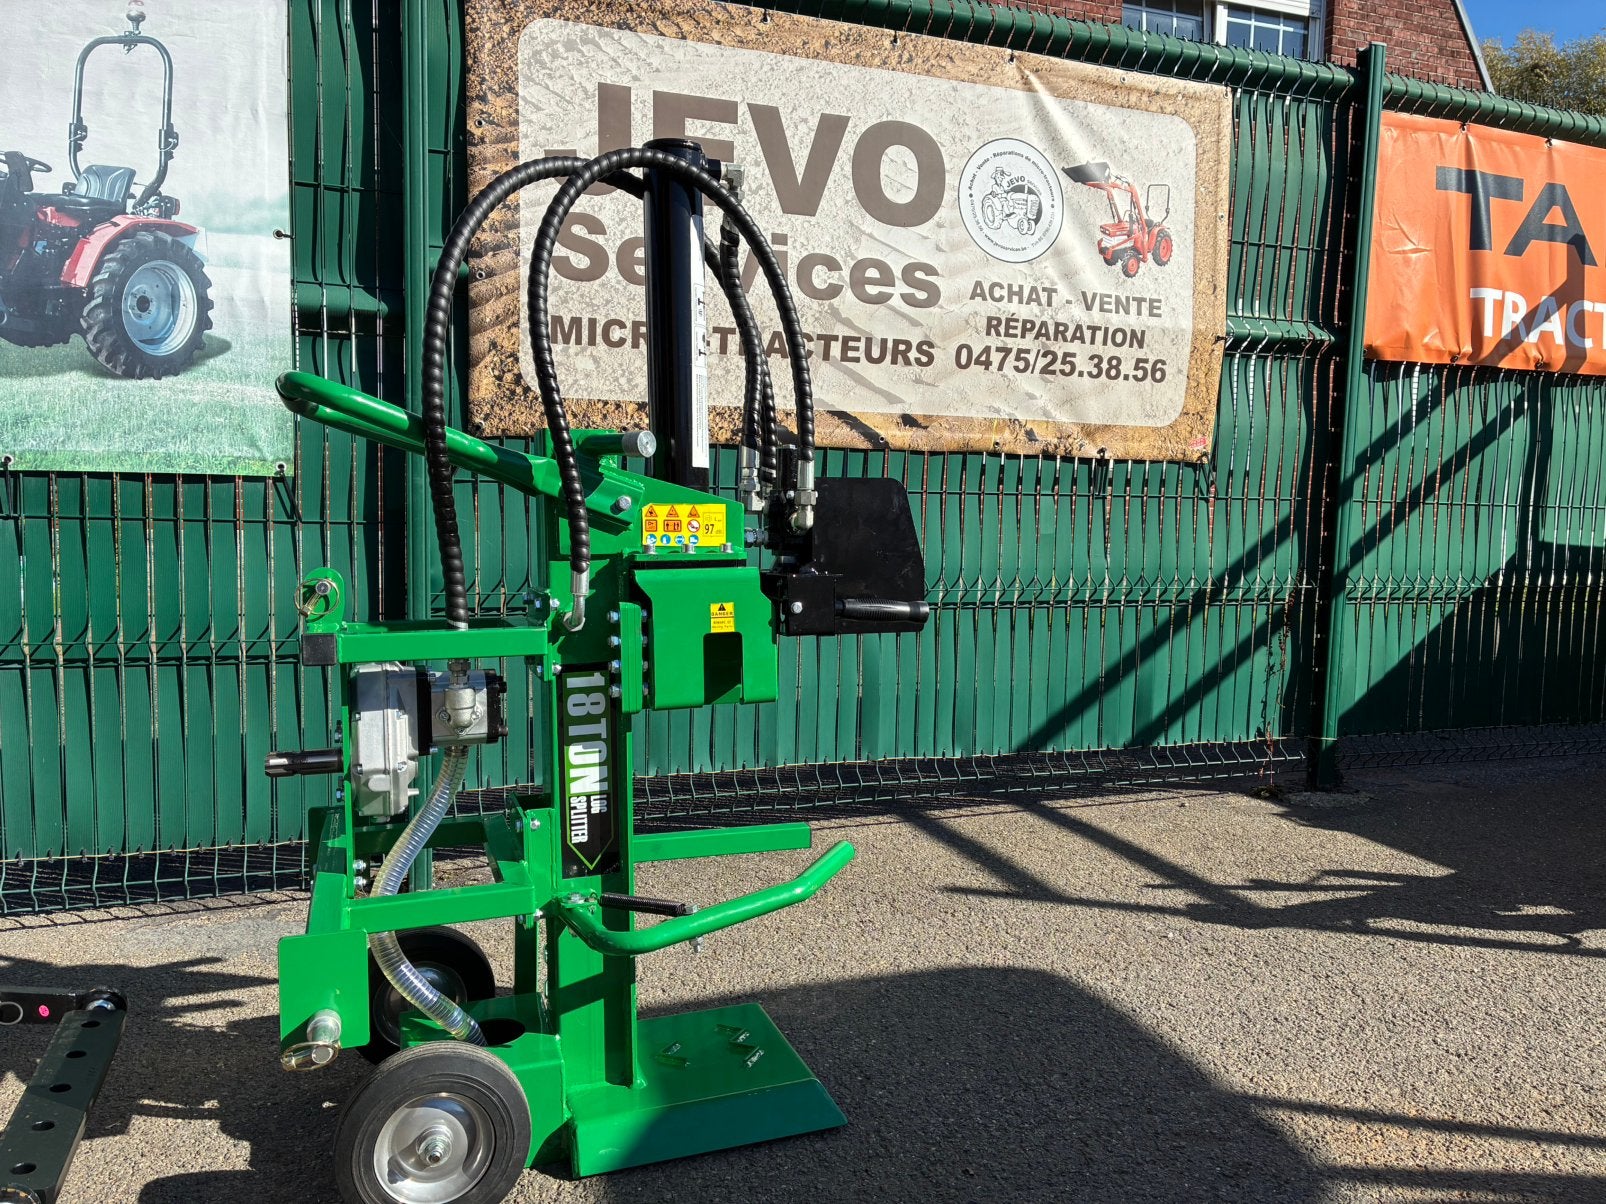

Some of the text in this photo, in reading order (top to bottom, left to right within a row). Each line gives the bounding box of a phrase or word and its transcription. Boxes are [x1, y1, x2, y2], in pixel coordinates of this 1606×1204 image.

[544, 82, 946, 227] JEVO
[1006, 175, 1026, 188] JEVO
[1436, 165, 1606, 267] TA
[551, 212, 942, 308] Seices
[969, 280, 1058, 307] ACHAT
[1080, 291, 1162, 318] VENTE
[551, 315, 935, 367] MICR-TATEURS
[985, 313, 1146, 349] RÉPARATION
[954, 343, 1167, 383] 0475/25.38.56
[704, 523, 715, 535] 97
[569, 795, 589, 845] SPLITTER
[590, 794, 607, 814] LOG
